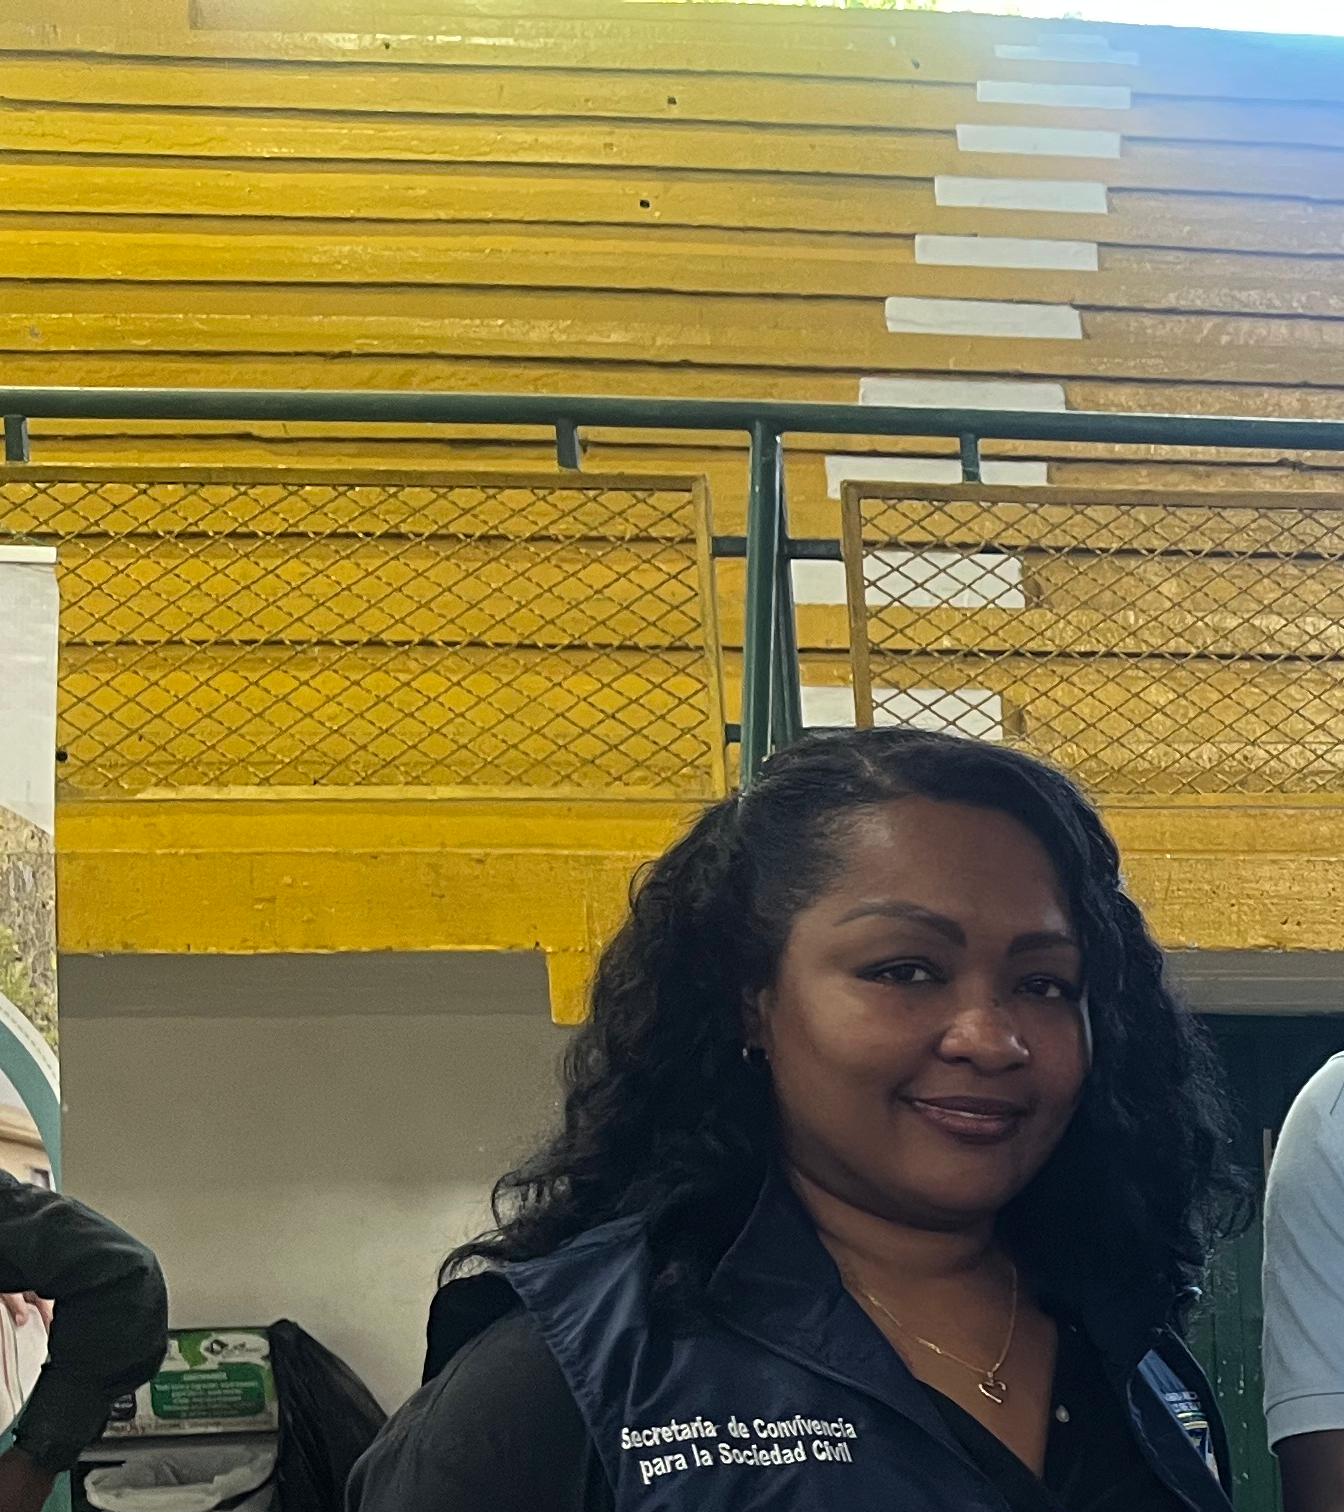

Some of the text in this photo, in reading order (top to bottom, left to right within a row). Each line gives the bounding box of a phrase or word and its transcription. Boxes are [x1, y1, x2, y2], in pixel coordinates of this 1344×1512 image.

[727, 1416, 750, 1439] de
[753, 1415, 857, 1439] Convivencia
[640, 1440, 853, 1484] para la Sociedad Civil
